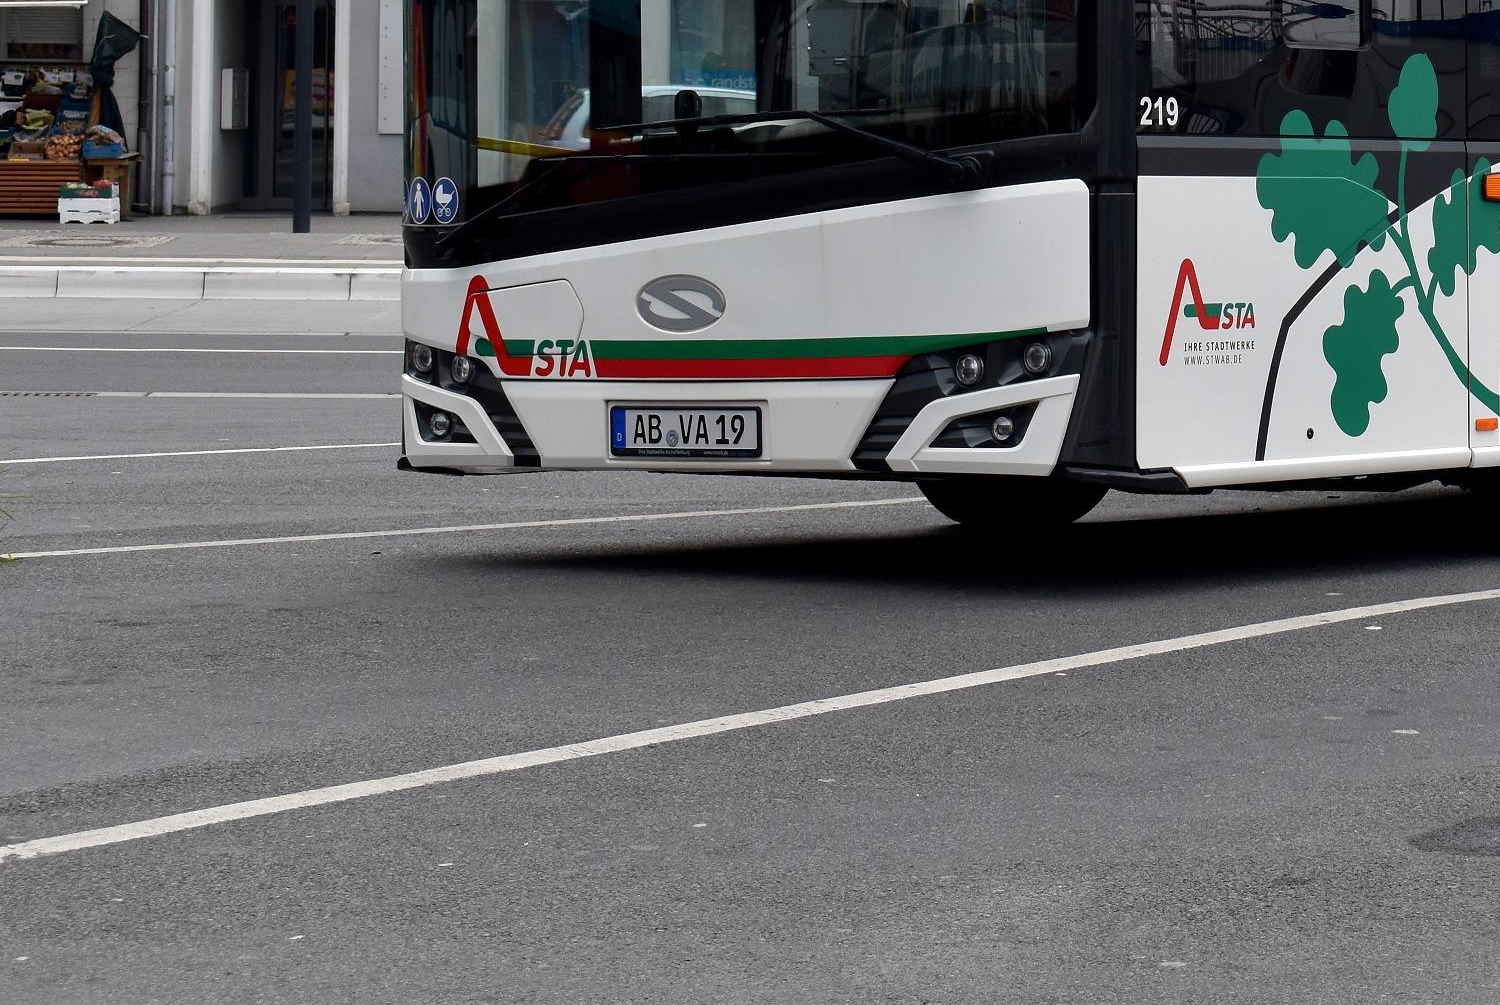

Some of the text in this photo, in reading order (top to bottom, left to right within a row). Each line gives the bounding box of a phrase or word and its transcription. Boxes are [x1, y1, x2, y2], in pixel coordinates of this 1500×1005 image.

[1140, 96, 1179, 126] 219
[1184, 340, 1255, 352] IHRE STADTWERKE
[1184, 354, 1242, 366] WWW.STWAB.DE
[633, 414, 745, 445] AB VA 19
